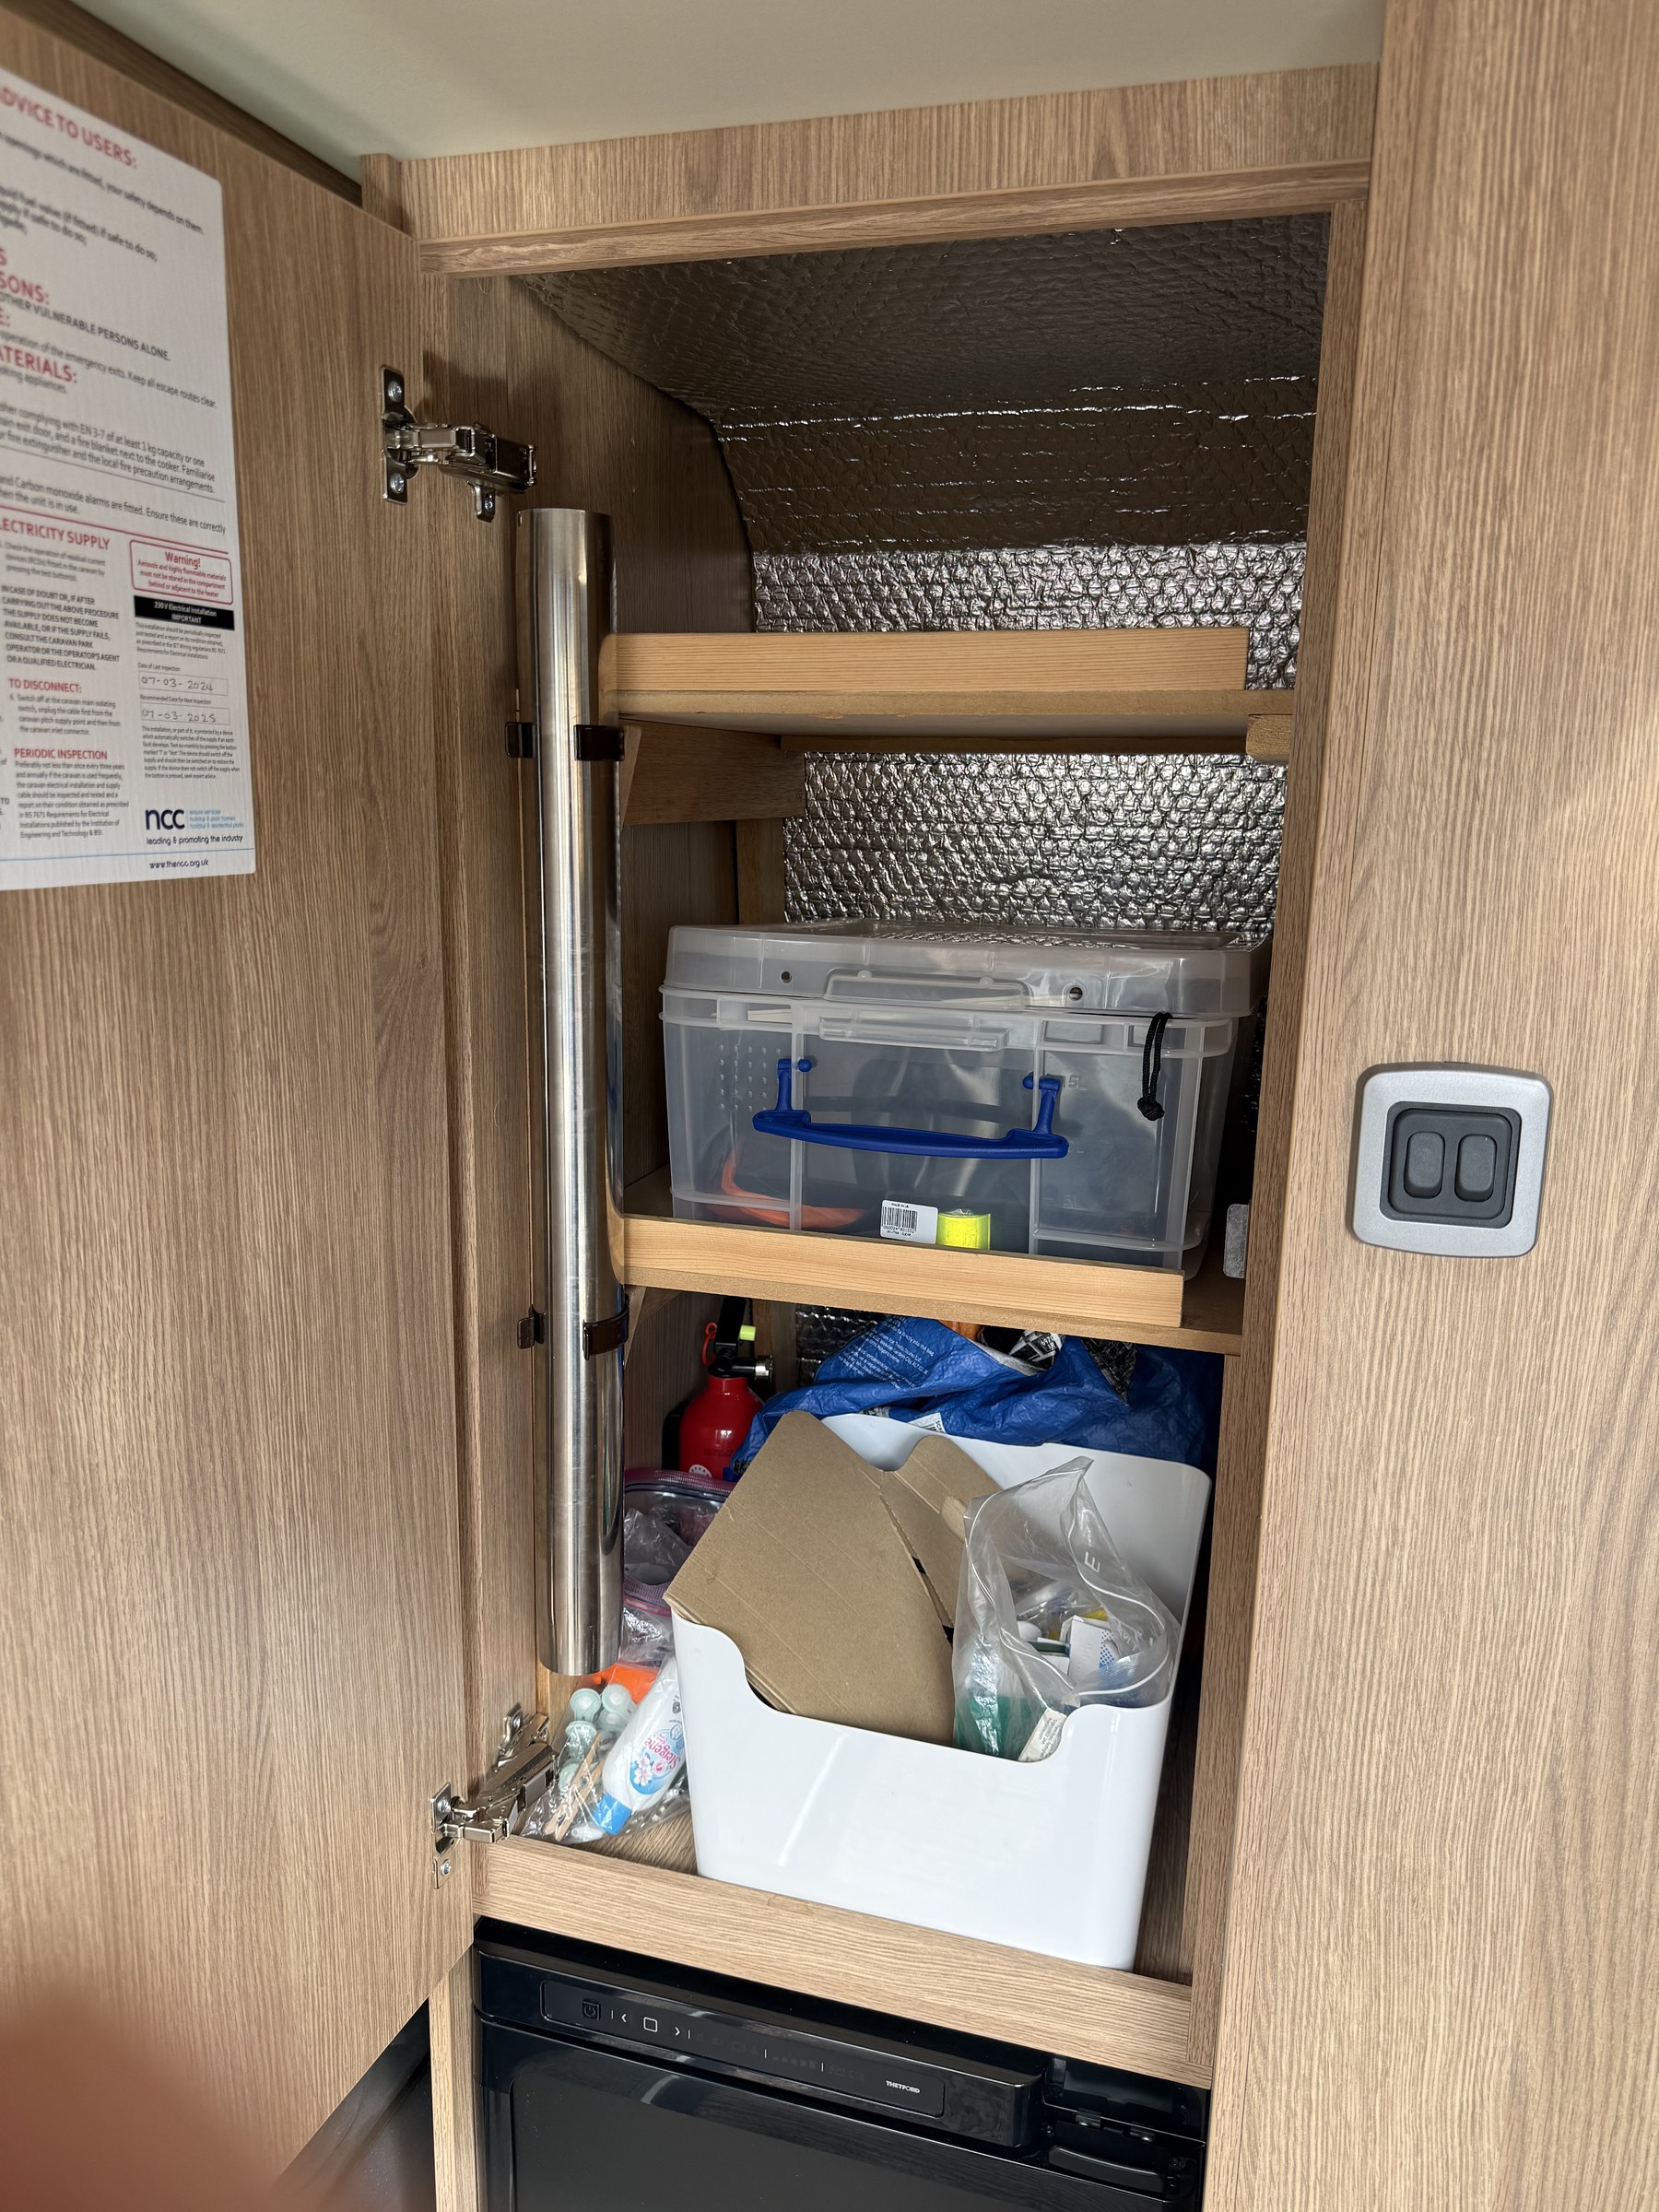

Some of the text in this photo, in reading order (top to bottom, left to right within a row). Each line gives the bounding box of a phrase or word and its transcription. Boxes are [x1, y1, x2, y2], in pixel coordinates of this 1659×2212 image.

[0, 87, 54, 128] DVICE
[55, 113, 79, 139] TO
[82, 126, 137, 169] USERS:
[0, 271, 49, 305] SONS:
[33, 305, 97, 335] VULNERABLE
[98, 326, 139, 350] PERSONS
[140, 342, 171, 361] ALONE.
[16, 477, 44, 492] Carbon
[85, 494, 111, 508] alarms
[112, 501, 123, 510] are
[124, 500, 145, 516] fitted.
[147, 507, 170, 522] Ensure
[171, 512, 188, 525] these
[189, 517, 199, 528] are
[200, 520, 227, 535] correctly
[67, 530, 111, 550] SUPPLY
[164, 551, 201, 571] Warning!
[169, 602, 191, 614] Electrical
[171, 612, 202, 624] IMPORTANT
[8, 678, 82, 694] TO DISCONNECT:
[14, 748, 108, 760] PERIODIC INSPECTION
[145, 809, 185, 830] ncc
[147, 837, 171, 846] leading
[179, 835, 209, 845] promoting
[210, 834, 220, 842] the
[221, 834, 243, 842] industry
[149, 859, 209, 869] www.thencc.org.uk
[885, 2079, 921, 2094] THETFORD
